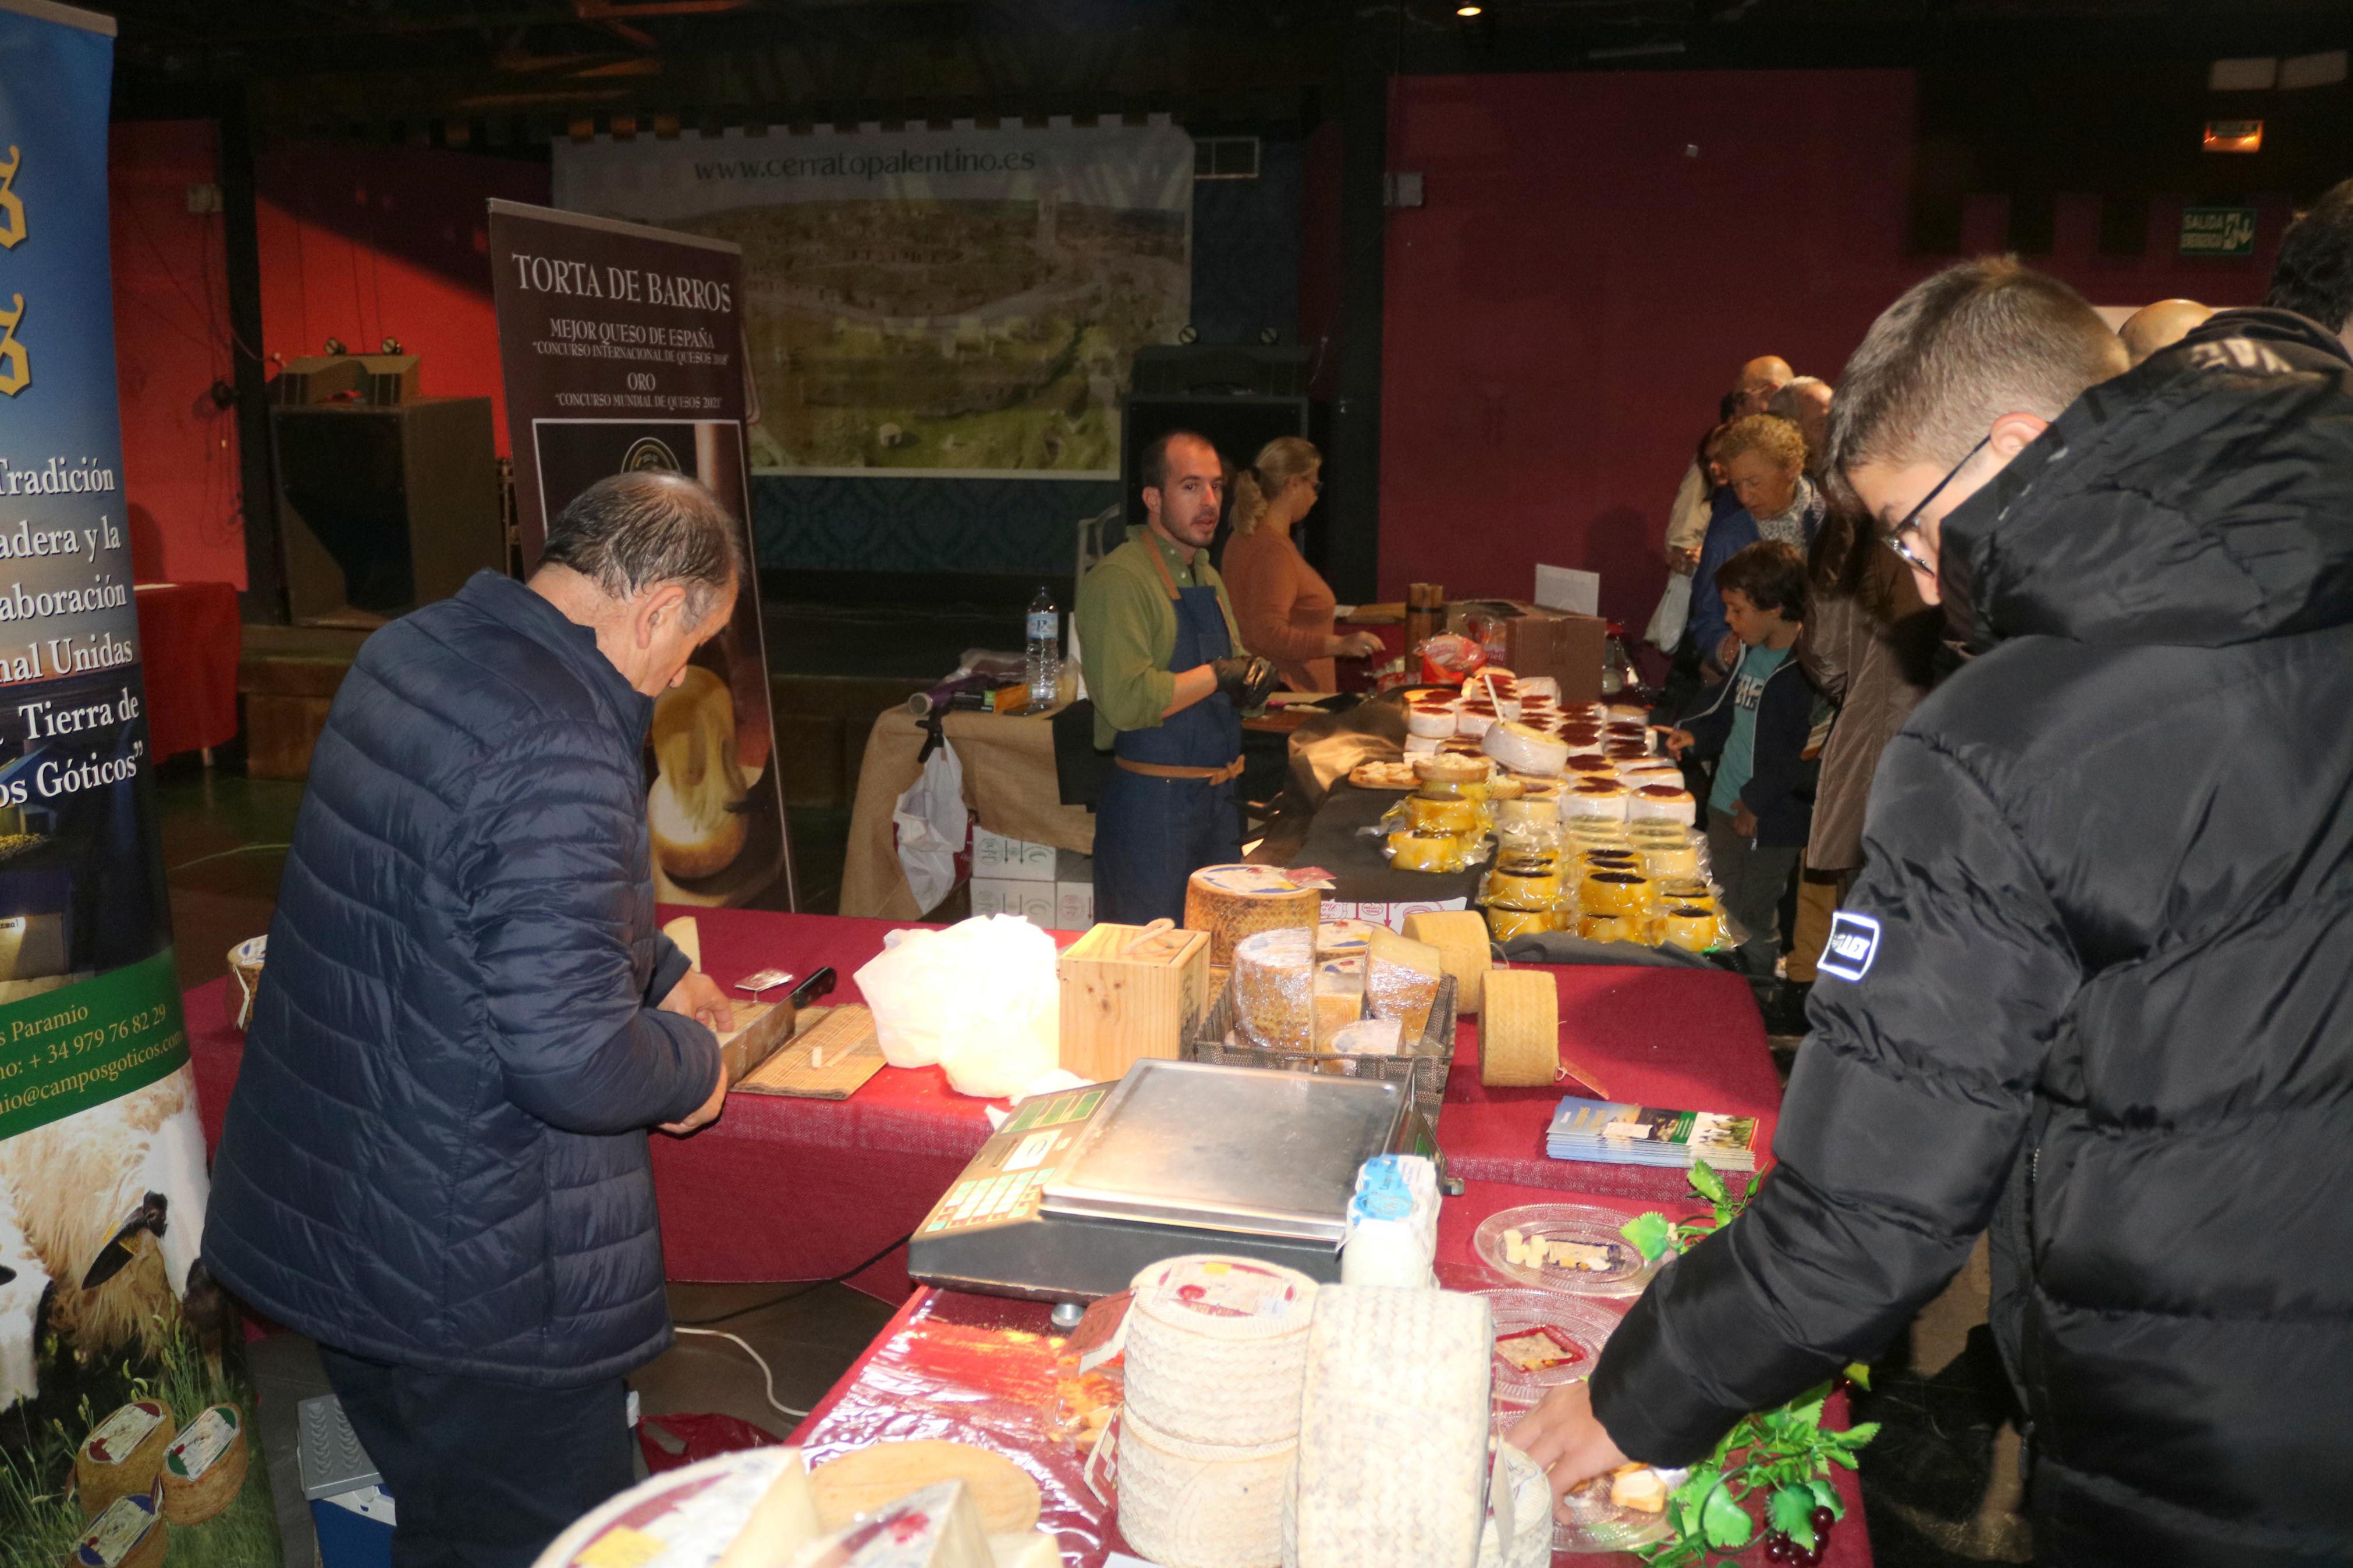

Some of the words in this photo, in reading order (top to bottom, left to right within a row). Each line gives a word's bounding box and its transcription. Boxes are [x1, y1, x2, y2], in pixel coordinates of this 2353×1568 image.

[695, 148, 1035, 180] www.cerratopalentino.es
[512, 253, 604, 298] TORTA
[607, 266, 641, 303] DE
[646, 272, 732, 313] BARROS
[550, 318, 597, 342] MEJOR
[599, 323, 646, 345] QUESO
[649, 327, 666, 345] DE
[670, 328, 715, 349] ESPAÑA
[592, 344, 663, 362] INTERNACIONAL
[664, 351, 676, 362] DE
[677, 351, 711, 365] QUESOS
[627, 372, 656, 391] ORO
[613, 394, 654, 407] MUNDIAL
[655, 396, 666, 407] DE
[668, 396, 701, 410] QUESOS
[84, 528, 98, 563] y
[101, 515, 121, 550] la
[48, 632, 133, 675] Unidas
[19, 701, 115, 740] Tierra
[118, 687, 140, 721] de
[10, 1005, 88, 1042] Paramio
[29, 1054, 41, 1071] +
[47, 1041, 69, 1065] 34
[73, 1029, 105, 1055] 979
[109, 1020, 129, 1043] 76
[132, 1012, 149, 1033] 82
[152, 1004, 166, 1026] 29
